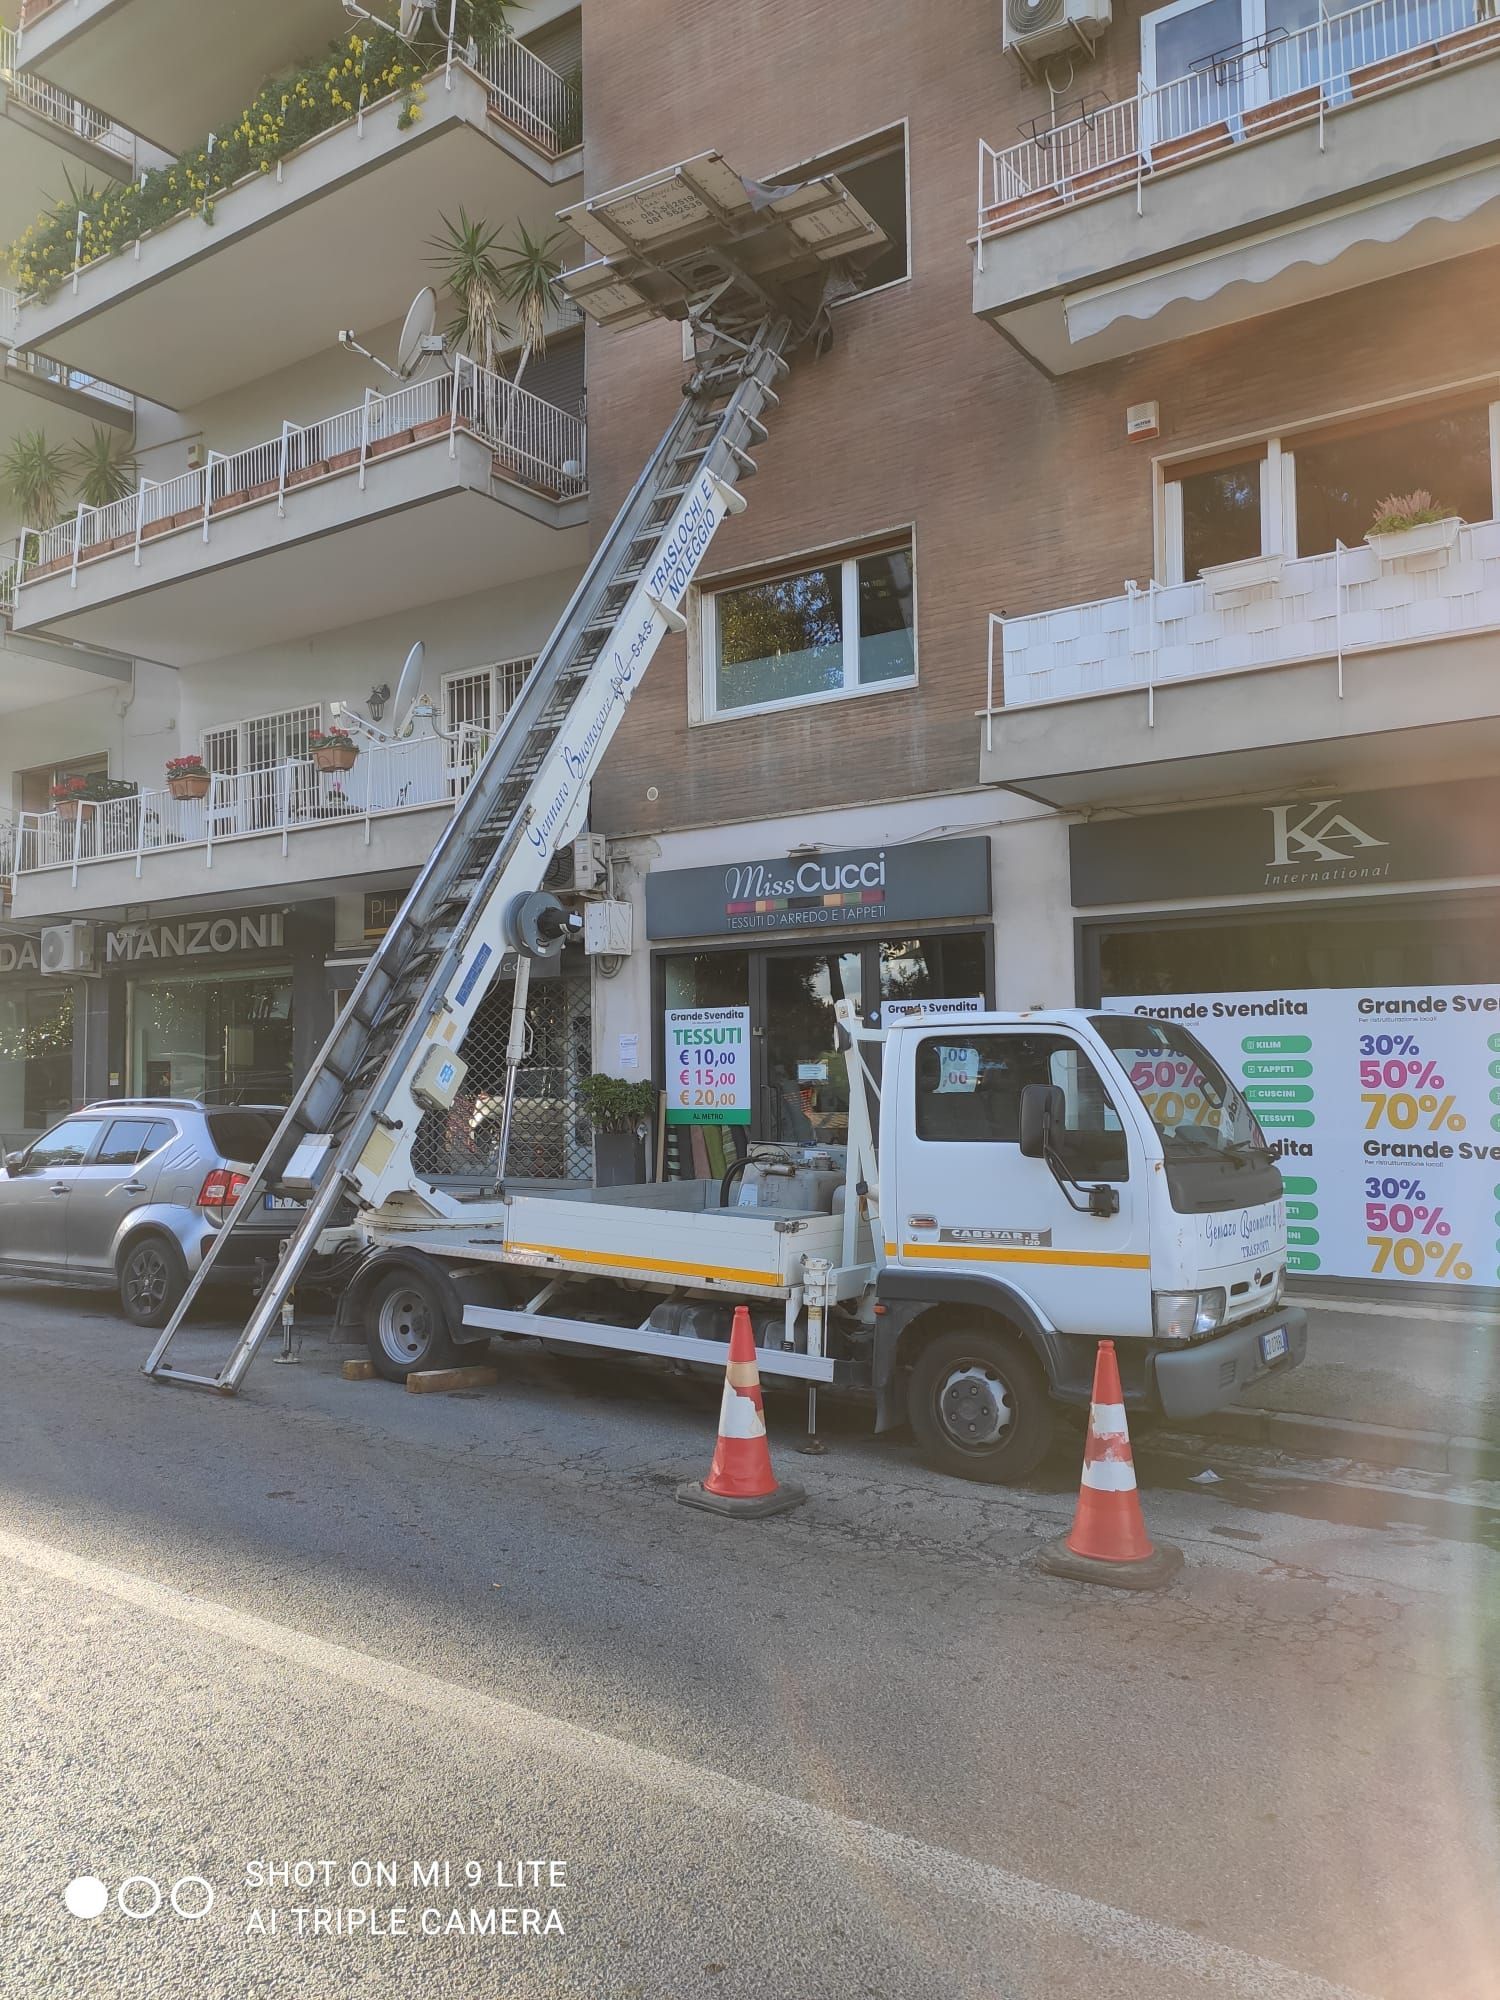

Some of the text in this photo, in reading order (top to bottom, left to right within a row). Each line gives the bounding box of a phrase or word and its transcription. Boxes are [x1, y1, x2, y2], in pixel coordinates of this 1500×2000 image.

[650, 479, 712, 595] TRASLOCHI E
[668, 508, 715, 601] NOLEGGIO
[526, 780, 570, 858] Gennaro
[1262, 799, 1390, 866] KA
[724, 852, 886, 899] Miss Cucci
[1264, 863, 1391, 886] International
[727, 905, 886, 929] TESSUTI D'ARREDO E TAPPETI
[106, 913, 285, 963] MANZONI
[670, 1009, 744, 1021] Grande Svendita
[928, 1001, 978, 1012] Svendita
[1134, 998, 1308, 1019] Grande Svendita
[1358, 995, 1500, 1014] Grande Sve
[673, 1027, 742, 1045] TESSUTI
[1256, 1041, 1281, 1049] KILIM
[1359, 1034, 1420, 1056] 30%
[680, 1049, 736, 1067] € 10,00
[1256, 1065, 1294, 1073] TAPPETI
[680, 1069, 736, 1087] € 15,00
[1359, 1060, 1445, 1089] 50%
[680, 1089, 736, 1107] € 20,00
[1259, 1114, 1295, 1122] TESSUTI
[1360, 1092, 1467, 1131] 70%
[1270, 1138, 1312, 1156] dita
[1363, 1139, 1454, 1159] Grande
[1365, 1177, 1426, 1200] 30%
[1365, 1202, 1452, 1236] 50%
[1367, 1236, 1473, 1280] 70%
